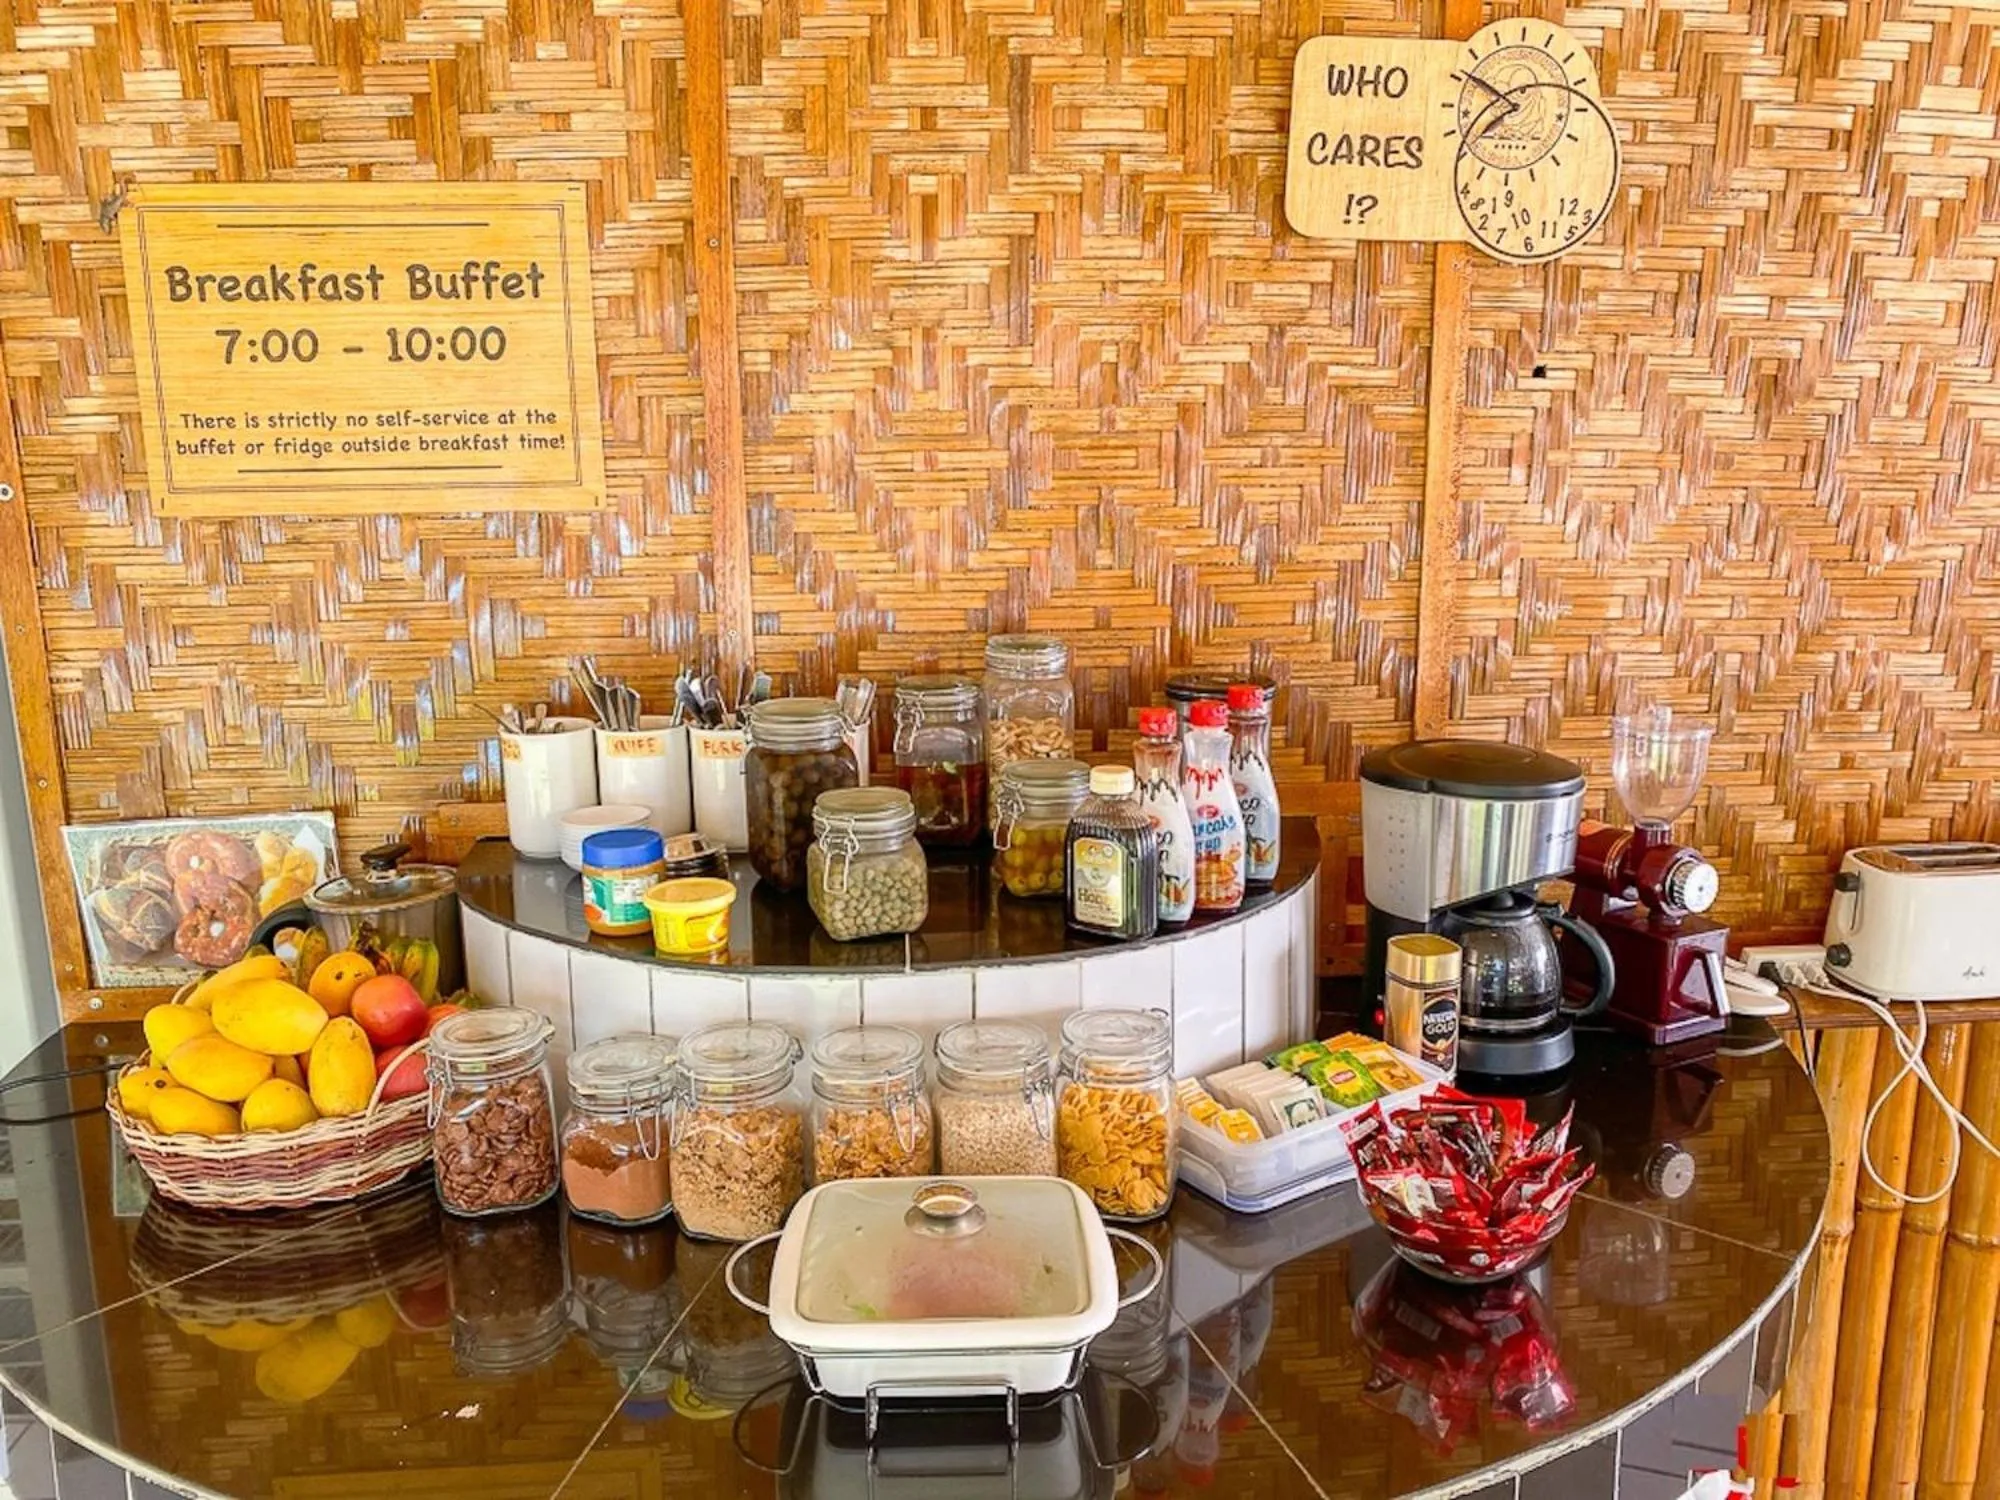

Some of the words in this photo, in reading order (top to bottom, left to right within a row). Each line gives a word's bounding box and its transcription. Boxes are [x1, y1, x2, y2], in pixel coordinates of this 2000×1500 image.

[1327, 64, 1409, 98] WHO
[1306, 132, 1424, 169] CARES
[1460, 183, 1471, 199] 4
[1504, 190, 1514, 208] 9
[1343, 194, 1379, 225] !?
[1469, 197, 1485, 210] 8
[1559, 198, 1579, 216] 12
[1478, 214, 1489, 231] 2
[1511, 208, 1531, 230] 10
[1582, 209, 1593, 226] 3
[1496, 227, 1507, 244] 7
[1541, 220, 1557, 238] 11
[1564, 225, 1578, 241] 5
[1524, 236, 1534, 252] 6
[165, 262, 384, 302] Breakfast
[407, 261, 545, 300] Buffet
[215, 329, 319, 364] 7:00
[386, 325, 507, 363] 10:00
[180, 413, 237, 429] There
[244, 412, 260, 428] is
[268, 411, 337, 431] strictly
[346, 415, 368, 427] no
[376, 409, 489, 427] self-service
[497, 409, 516, 425] at
[525, 409, 557, 425] the
[176, 438, 236, 455] buffet
[244, 441, 265, 454] or
[273, 437, 333, 458] fridge
[341, 436, 410, 453] outside
[419, 434, 509, 451] breakfast
[519, 433, 565, 449] time!
[1425, 1021, 1456, 1036] GOLD
